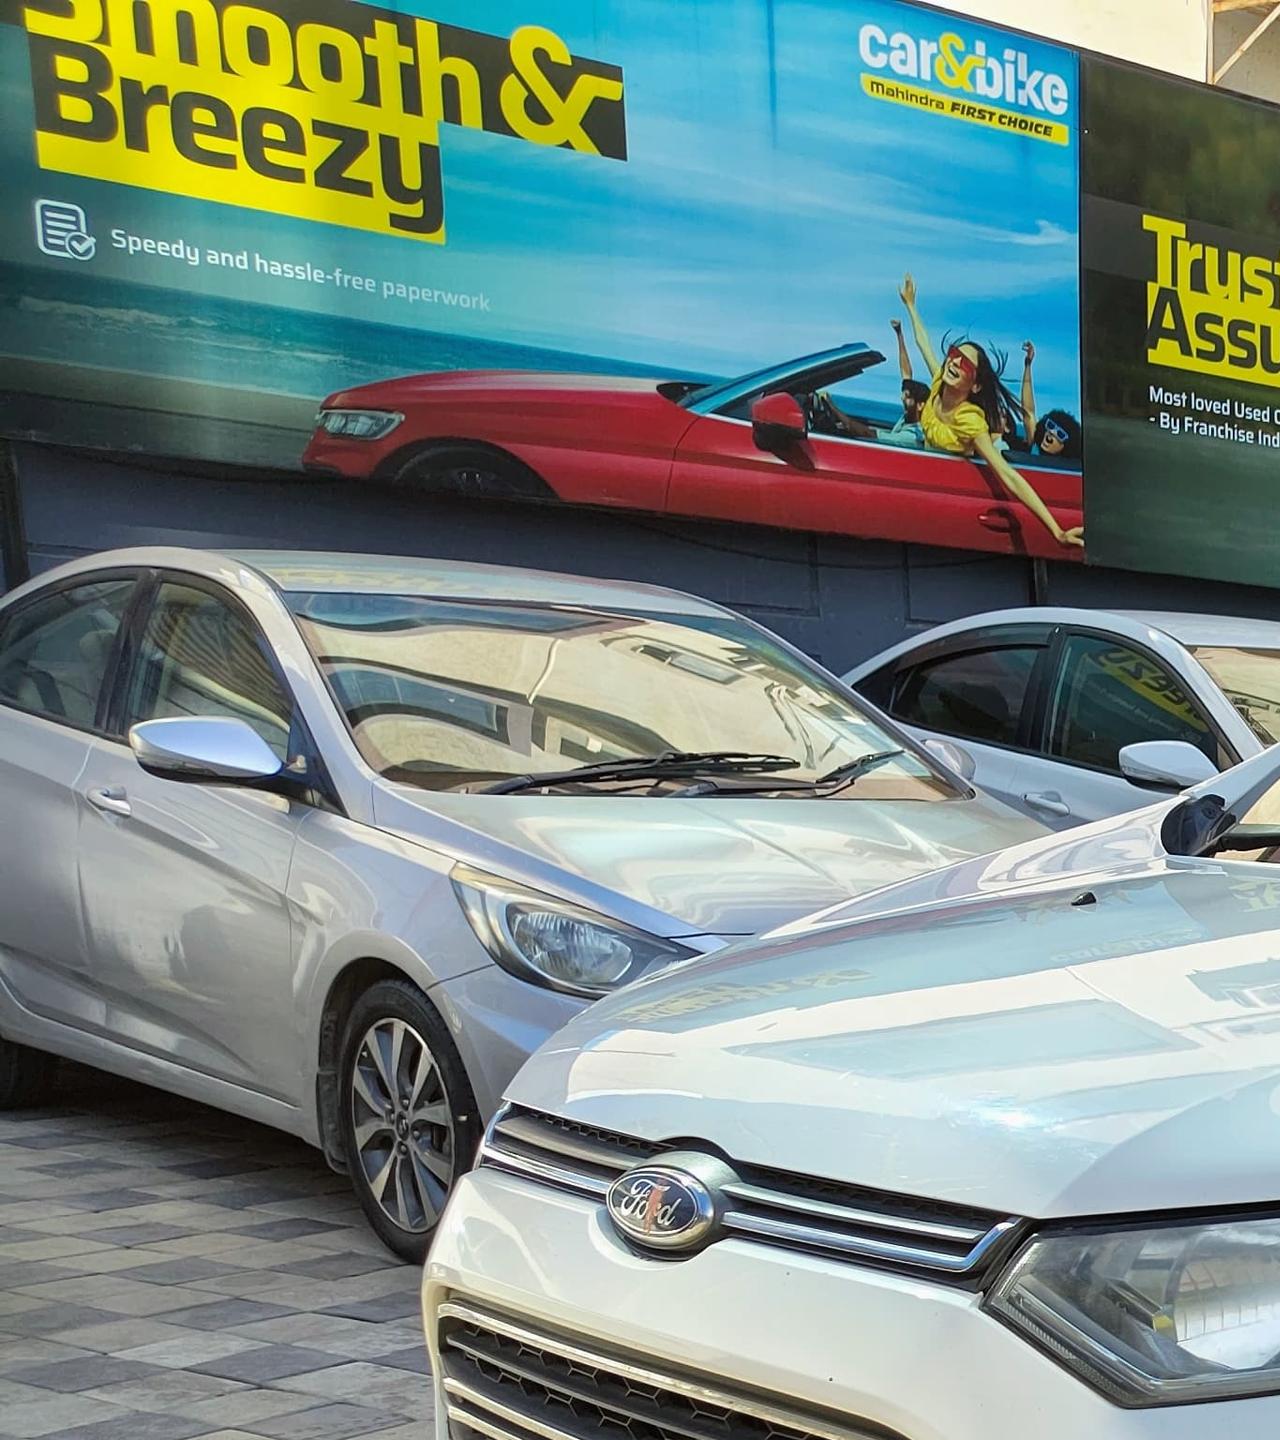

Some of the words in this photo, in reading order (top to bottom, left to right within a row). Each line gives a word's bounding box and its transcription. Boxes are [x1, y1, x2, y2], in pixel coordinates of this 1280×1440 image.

[500, 25, 623, 155] &
[859, 24, 1068, 115] car&bike
[29, 33, 443, 234] Breezy
[950, 102, 997, 124] FIRST
[998, 114, 1053, 137] CHOICE
[111, 229, 200, 266] Speedy
[206, 248, 249, 270] and
[255, 253, 376, 293] hassle-free
[382, 279, 491, 313] paperwork
[1149, 386, 1187, 407] Most
[1191, 392, 1230, 415] loved
[1235, 402, 1270, 423] Used
[1160, 412, 1179, 434] By
[1184, 416, 1254, 444] Franchise
